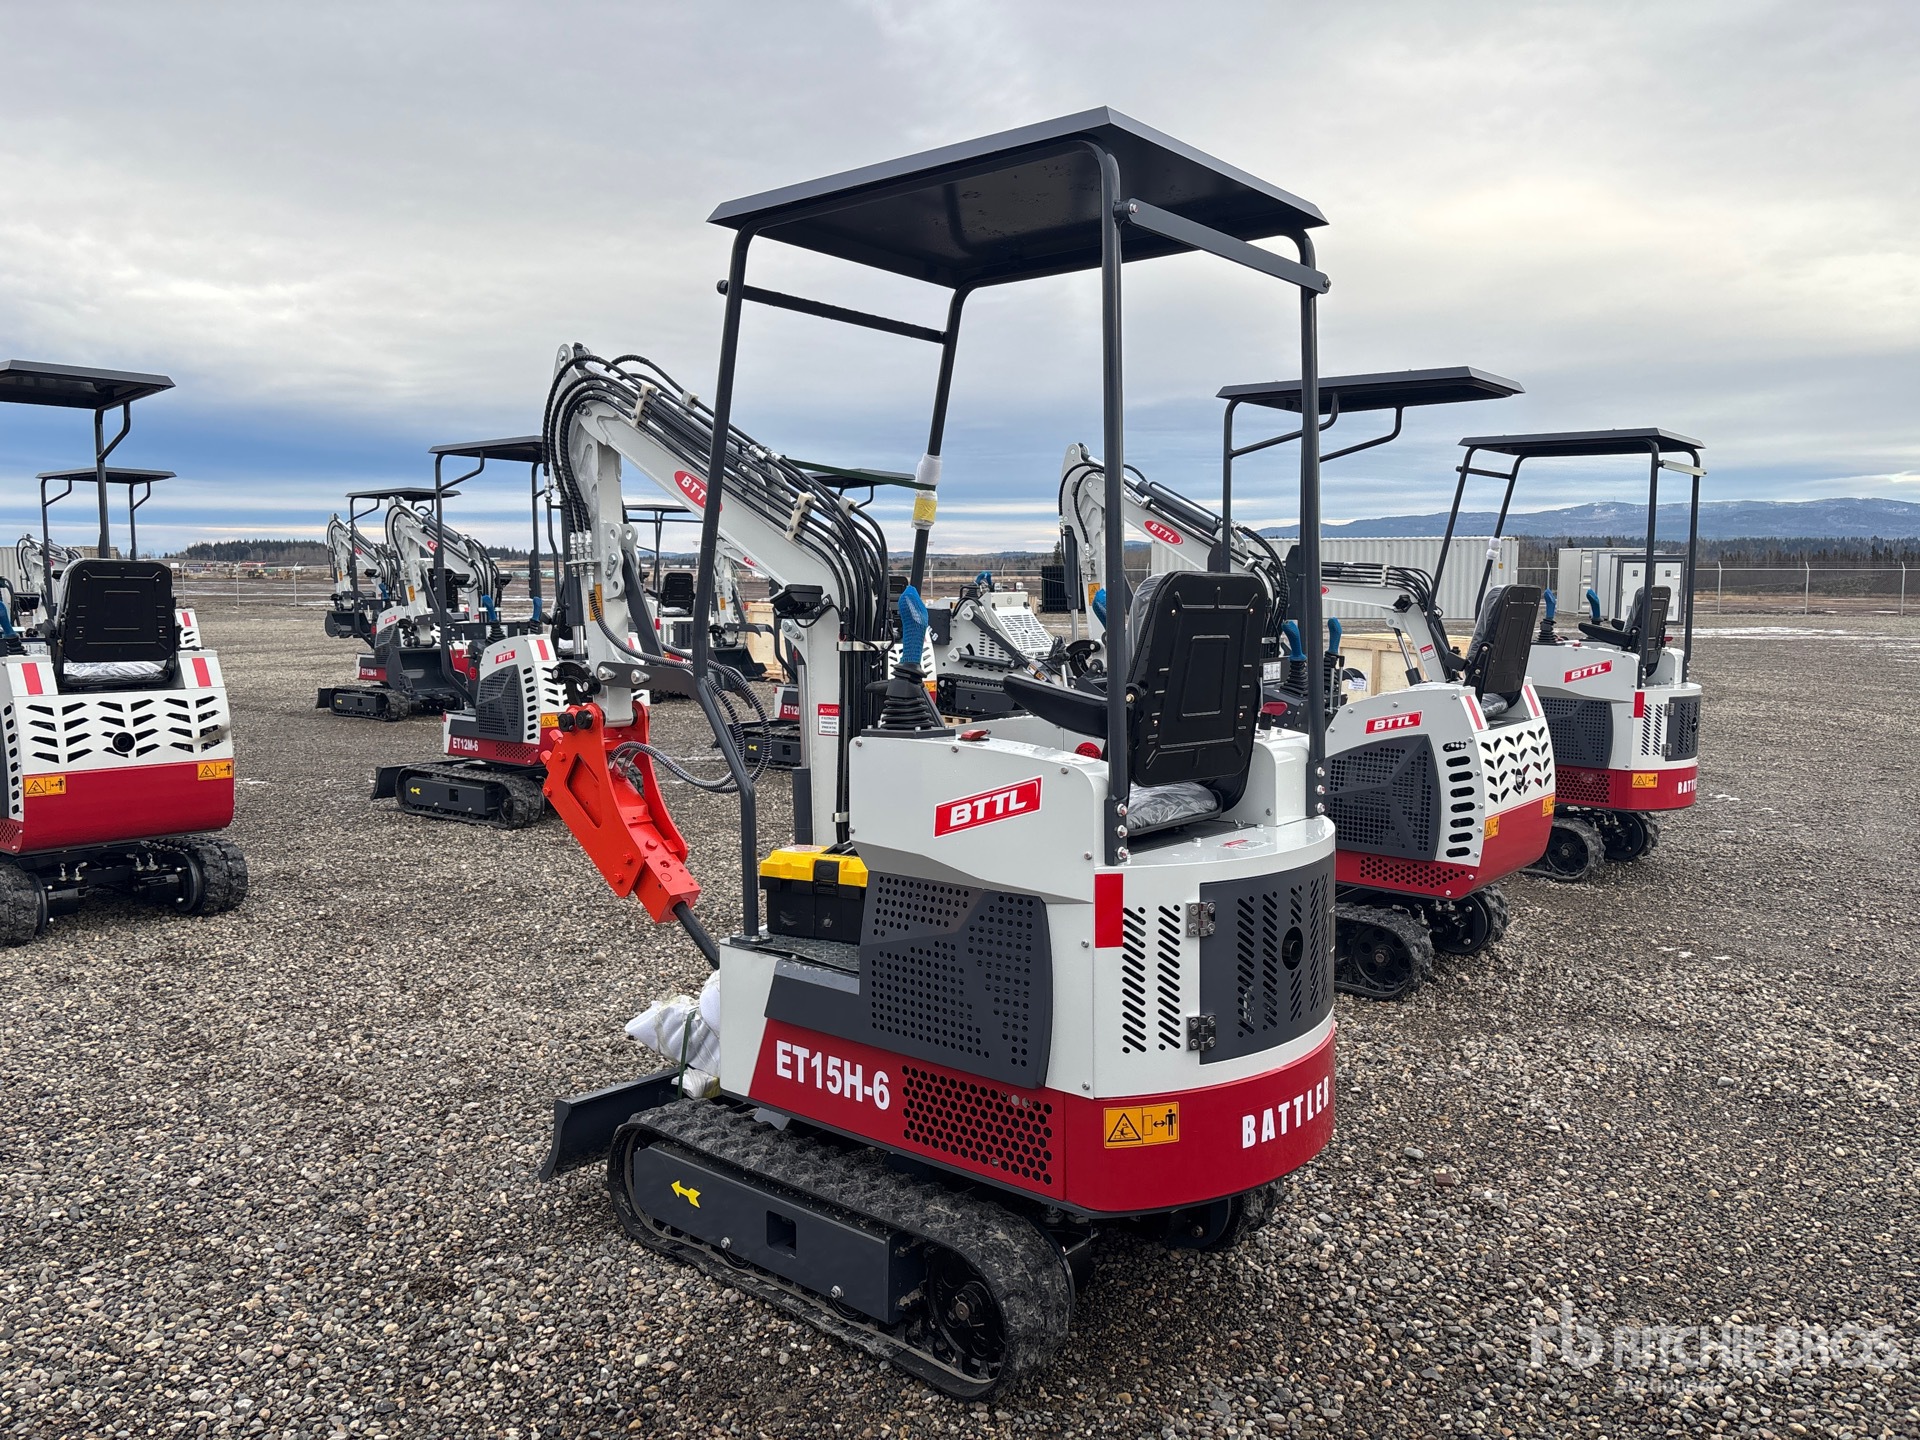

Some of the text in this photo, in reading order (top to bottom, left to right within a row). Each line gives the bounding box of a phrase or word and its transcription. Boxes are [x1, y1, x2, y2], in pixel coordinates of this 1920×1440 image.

[681, 475, 707, 505] BTT
[1150, 523, 1175, 542] BTTL
[1571, 664, 1606, 680] BTTL
[1373, 715, 1414, 731] BTTL
[452, 737, 479, 752] ET12M-6
[949, 789, 1028, 827] BTTL
[776, 1039, 891, 1110] ET15H-6
[1242, 1075, 1329, 1149] BATTLER
